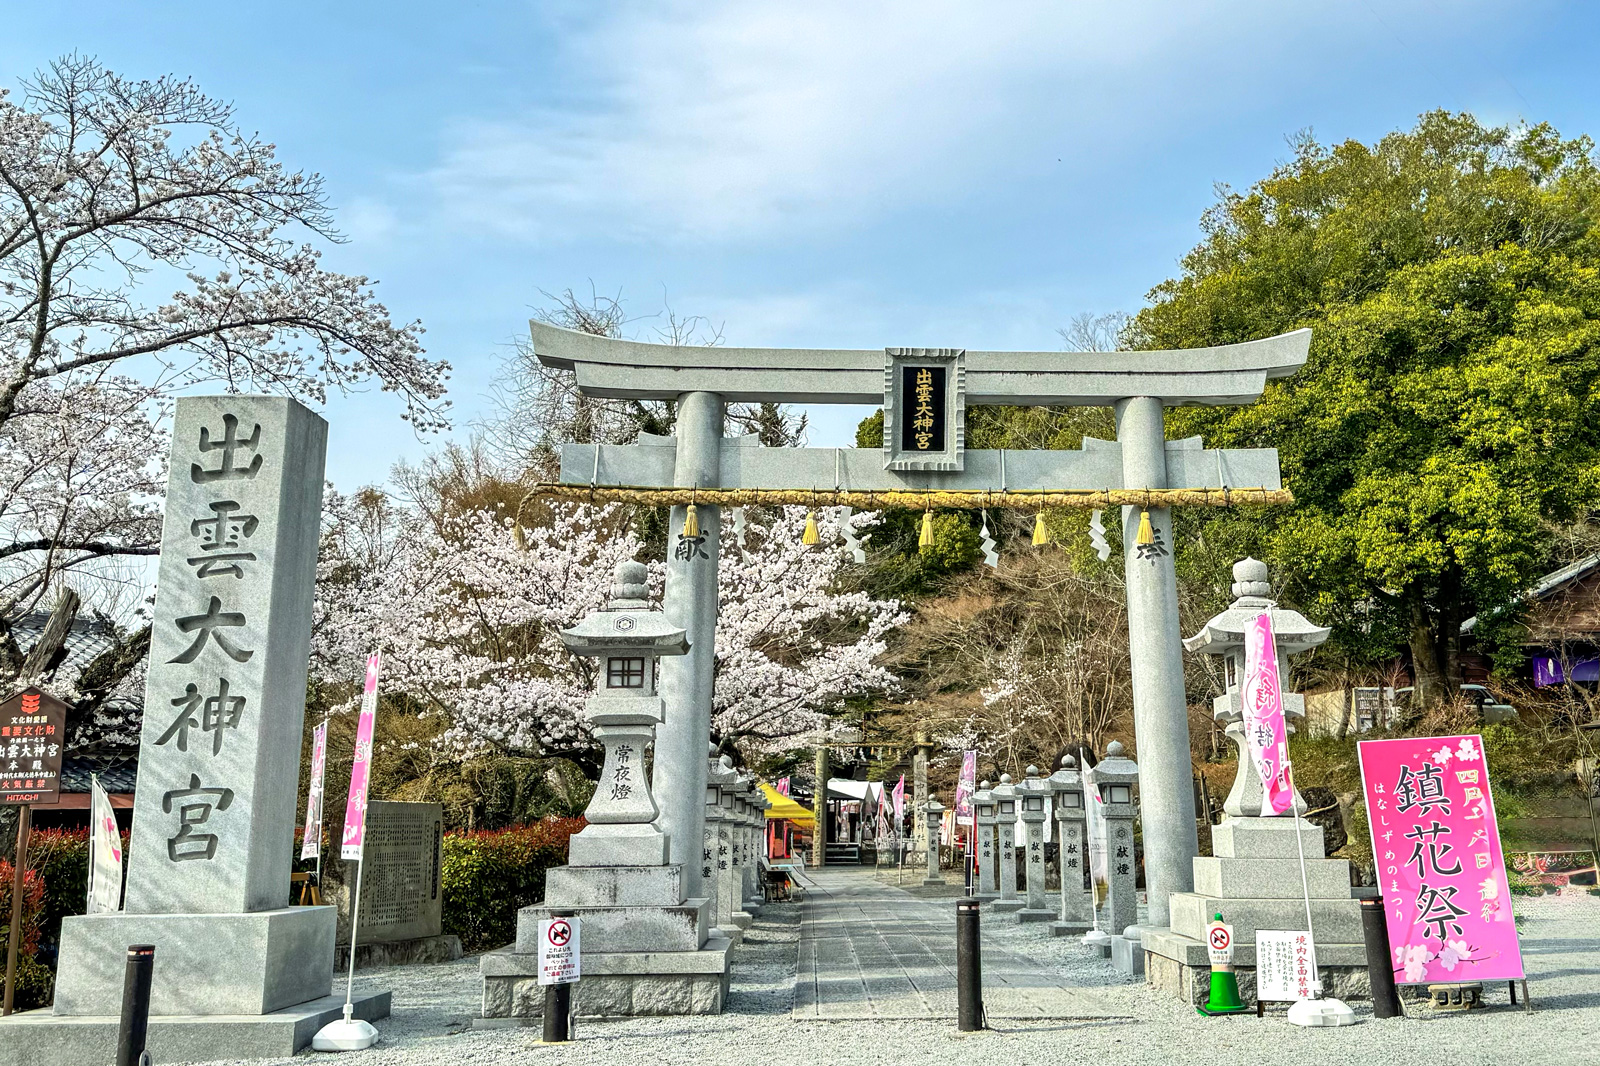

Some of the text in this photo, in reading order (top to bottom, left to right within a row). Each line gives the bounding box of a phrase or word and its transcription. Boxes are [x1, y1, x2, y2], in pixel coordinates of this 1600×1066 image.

[912, 368, 934, 450] 出雲大神宮
[153, 413, 263, 863] 出雲大神宮
[1, 725, 56, 736] 重要文化財
[6, 794, 39, 802] HITACHI
[610, 744, 634, 801] 常夜燈
[1031, 841, 1041, 864] 献燈
[1067, 843, 1078, 868] 献燈
[1116, 845, 1130, 875] 献燈
[1374, 782, 1403, 922] はなしずめのまつり
[1392, 762, 1471, 941] 鎮花祭
[1296, 935, 1310, 997] 境内全面禁煙
